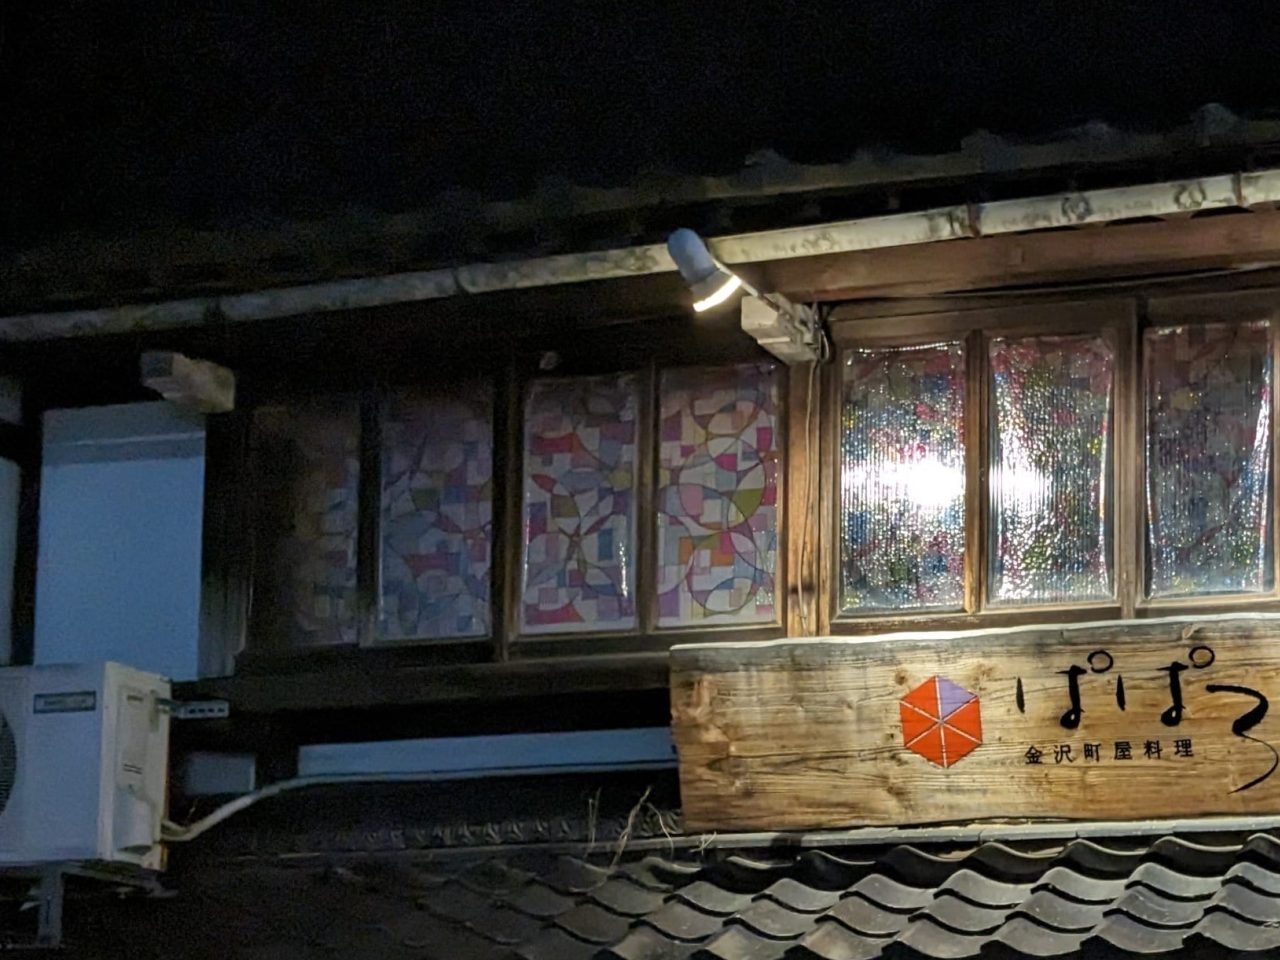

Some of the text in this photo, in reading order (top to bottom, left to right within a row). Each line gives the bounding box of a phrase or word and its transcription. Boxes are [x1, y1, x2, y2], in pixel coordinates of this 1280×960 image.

[1024, 738, 1195, 765] 金沢町屋料理
